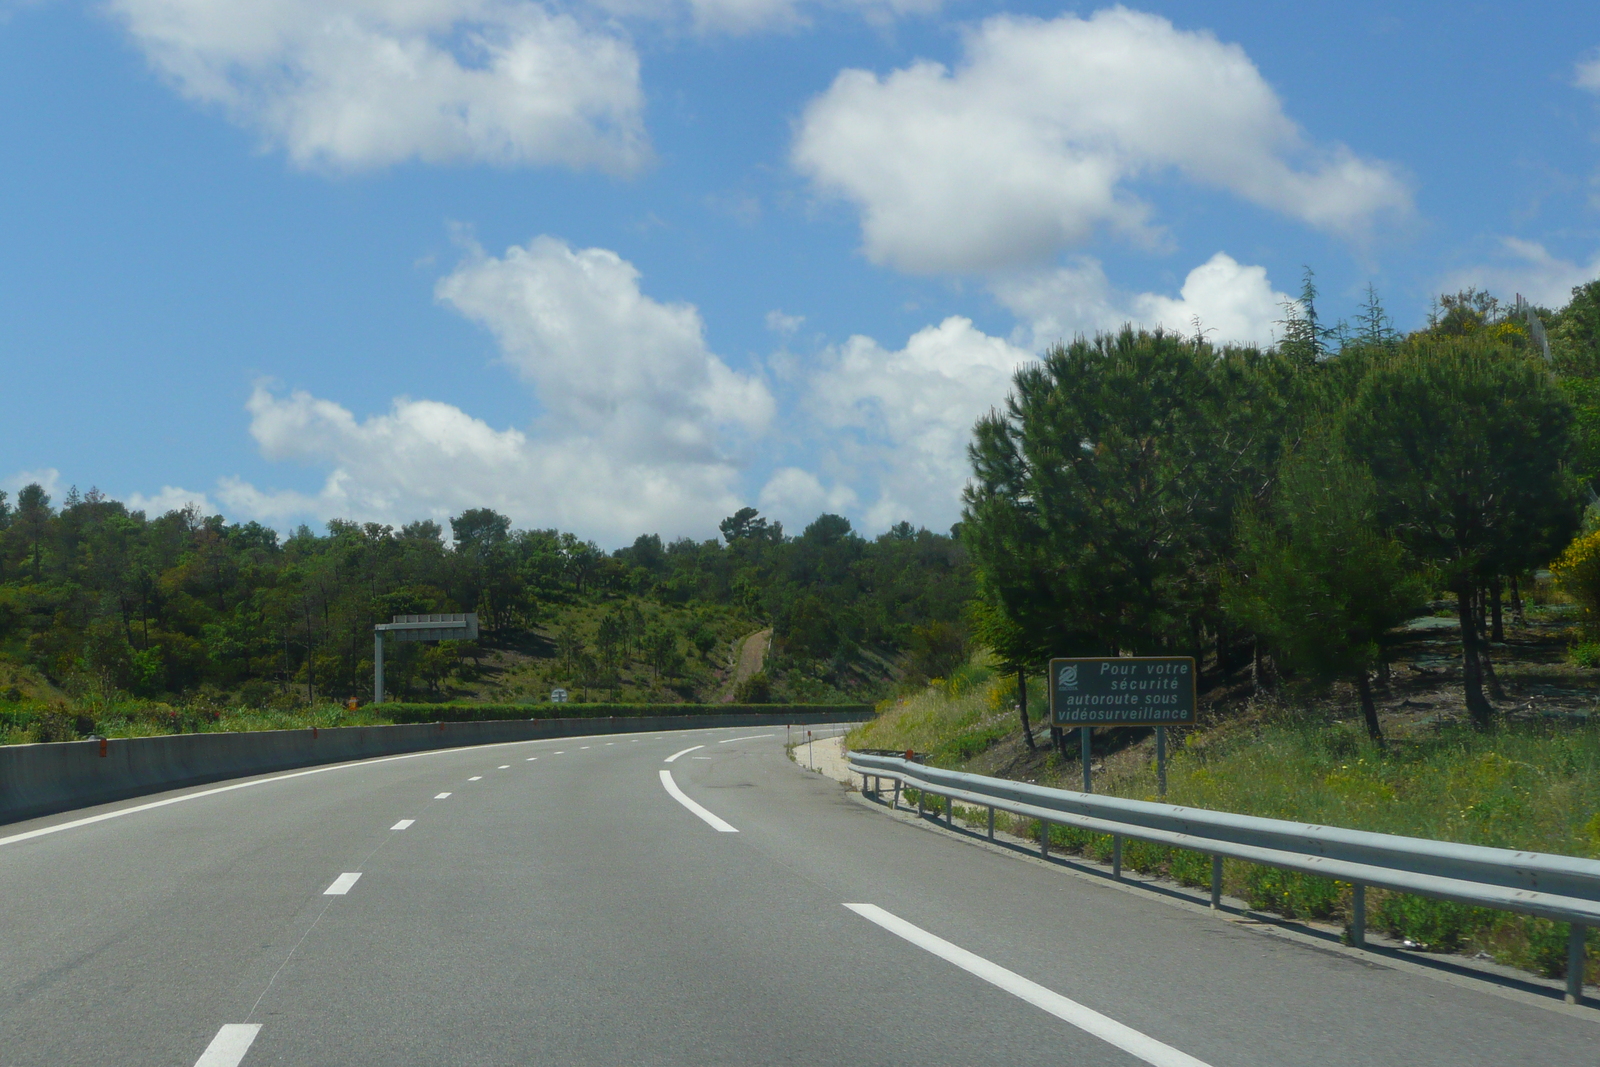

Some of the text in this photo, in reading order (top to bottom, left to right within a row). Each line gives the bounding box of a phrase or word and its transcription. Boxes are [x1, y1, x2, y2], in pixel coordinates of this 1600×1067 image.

[1100, 662, 1188, 675] Pour votre
[1111, 677, 1179, 690] sécurité
[1066, 694, 1178, 705] autoroute sous
[1058, 707, 1188, 721] vidéosurveillance
